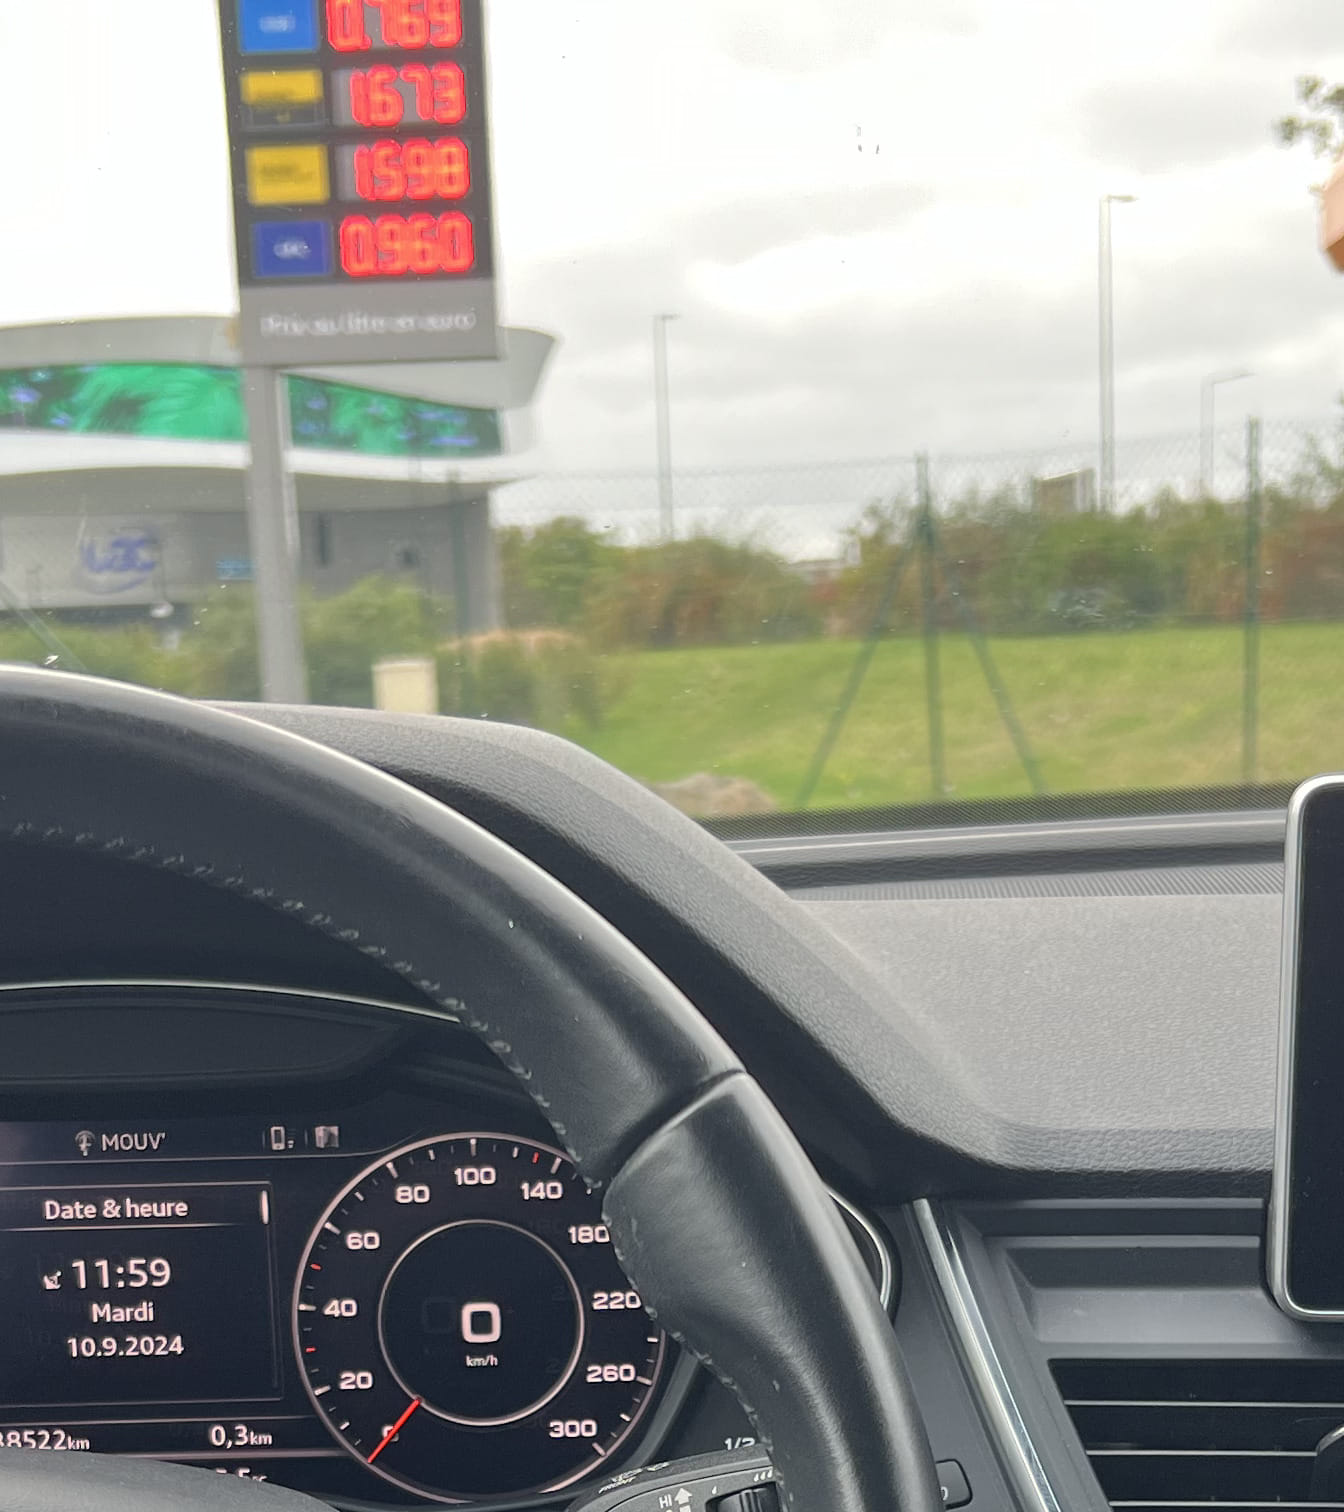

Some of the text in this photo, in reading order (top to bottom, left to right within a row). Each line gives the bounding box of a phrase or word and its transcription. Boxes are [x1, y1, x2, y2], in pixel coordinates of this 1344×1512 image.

[455, 1168, 496, 1185] 100
[396, 1186, 430, 1203] 80
[521, 1182, 562, 1199] 140
[44, 1198, 189, 1221] Date & heure
[346, 1232, 380, 1250] 60
[568, 1226, 610, 1244] 180
[71, 1258, 172, 1289] 11:59
[324, 1300, 357, 1318] 40
[592, 1292, 641, 1310] 220
[92, 1301, 155, 1323] Mardi
[462, 1303, 501, 1343] 0
[67, 1335, 184, 1358] 10.9.2024
[466, 1355, 498, 1367] km/h
[340, 1372, 373, 1389] 20
[586, 1365, 636, 1383] 260
[549, 1420, 597, 1438] 300
[659, 1494, 672, 1508] HI
